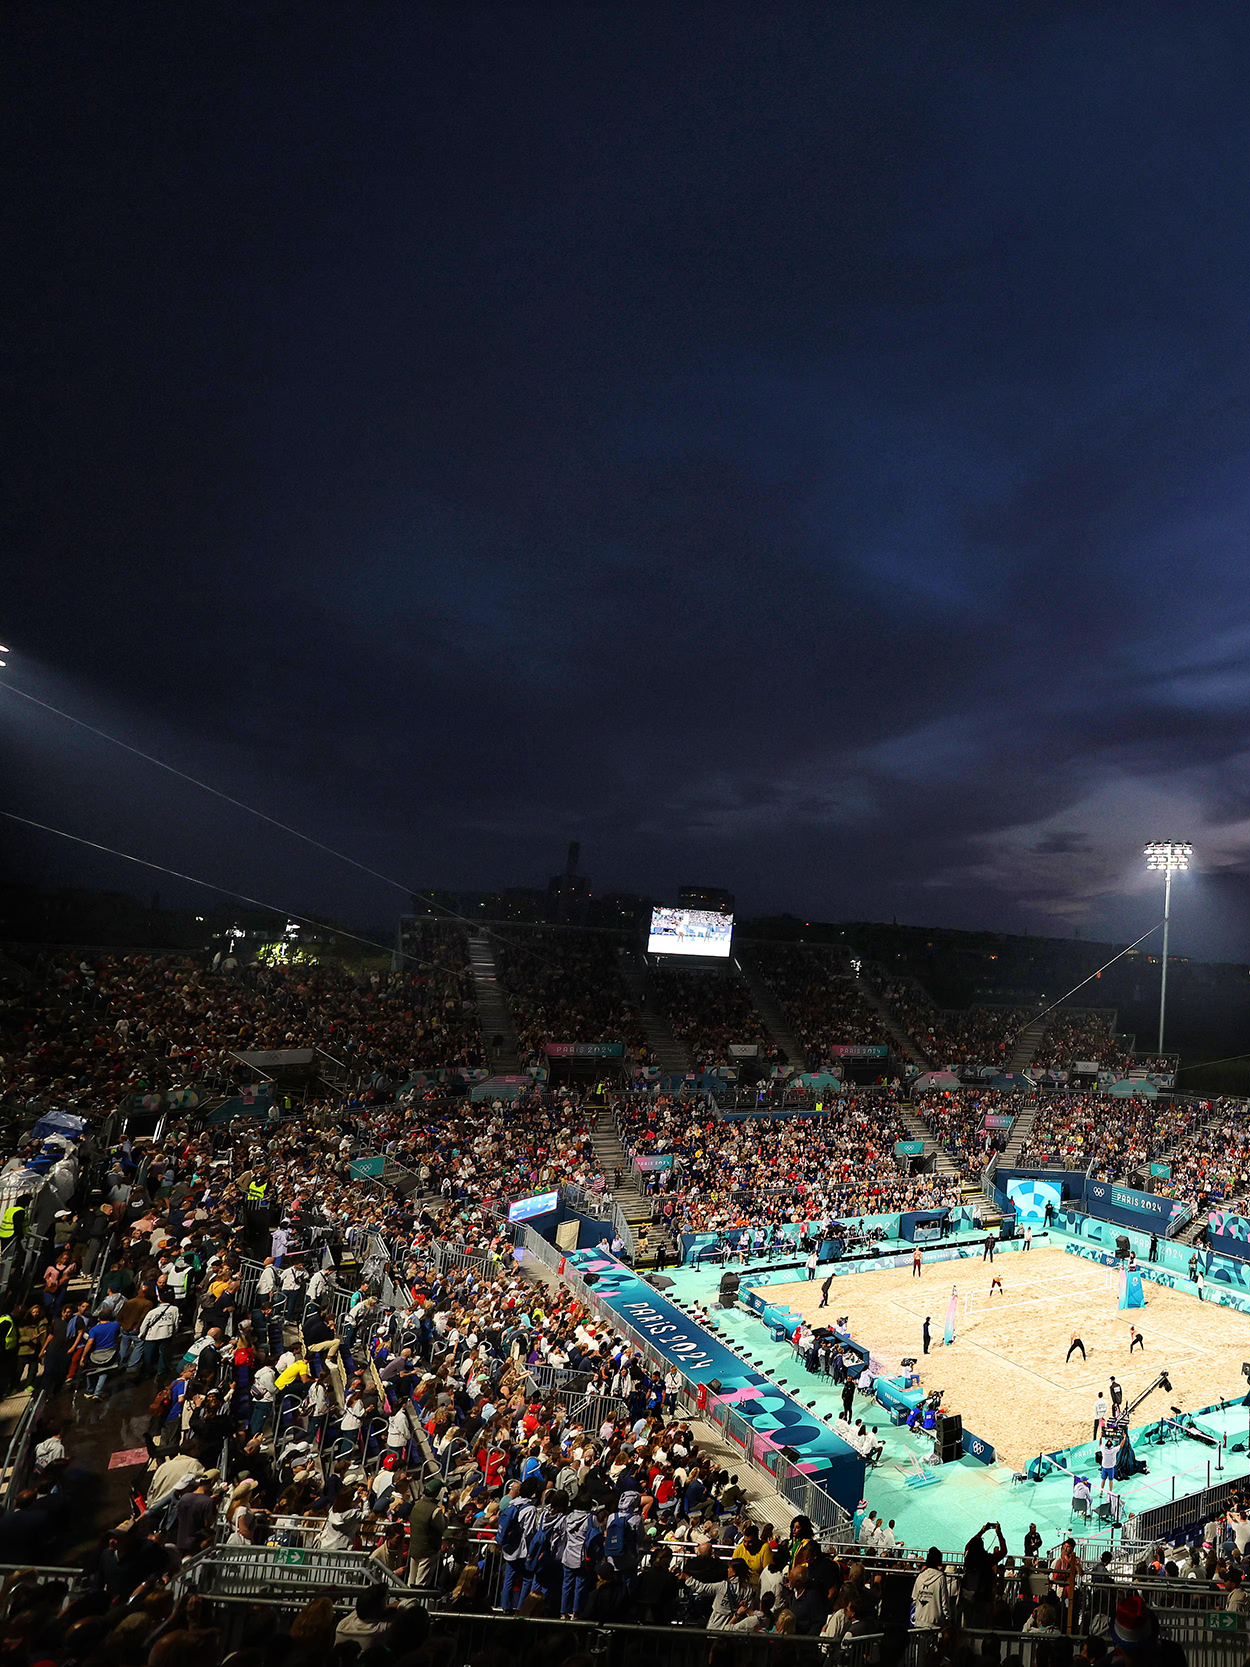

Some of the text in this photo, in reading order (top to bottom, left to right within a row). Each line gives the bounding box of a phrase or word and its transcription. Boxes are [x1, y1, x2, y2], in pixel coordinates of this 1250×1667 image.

[1141, 1199, 1162, 1213] 2024
[1161, 1245, 1184, 1260] 2024
[658, 1334, 714, 1370] 2024
